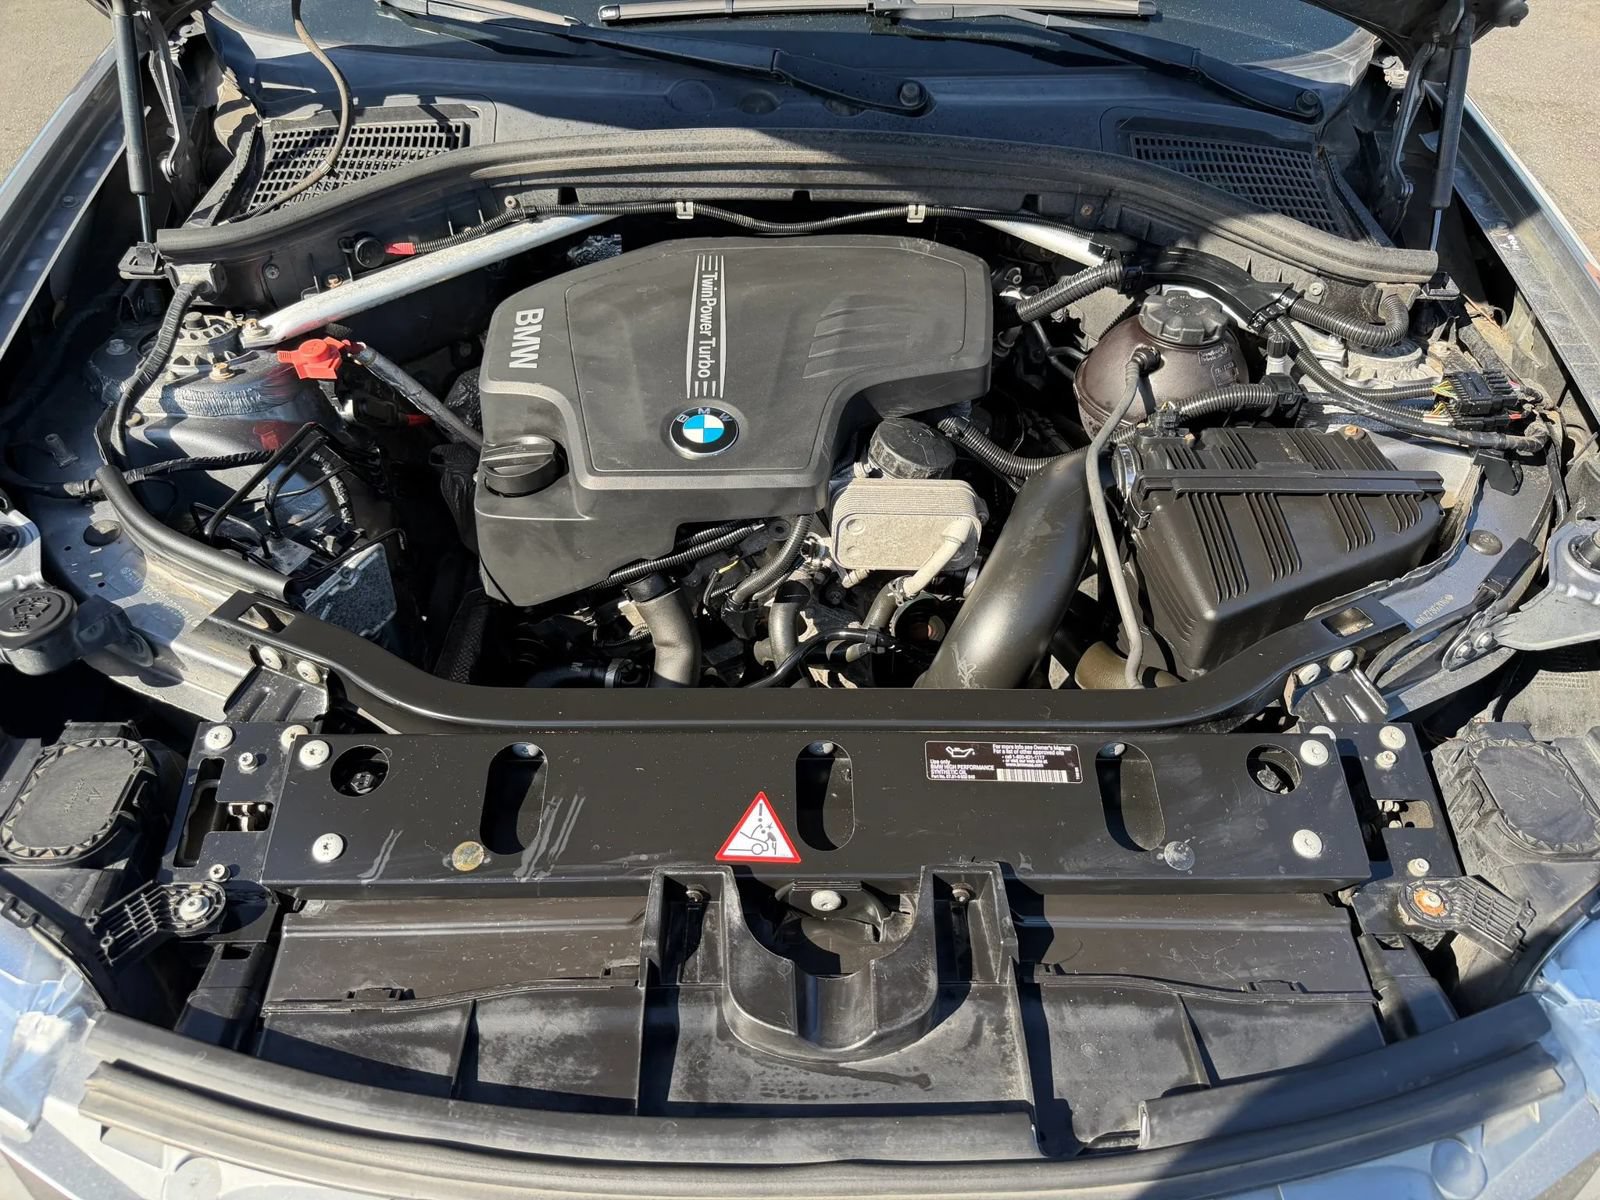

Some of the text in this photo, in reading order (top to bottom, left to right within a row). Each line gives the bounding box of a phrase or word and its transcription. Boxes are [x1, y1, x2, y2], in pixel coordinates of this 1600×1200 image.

[509, 308, 544, 369] BMW
[698, 272, 718, 378] TwinPower Turbo
[676, 407, 733, 424] BMW
